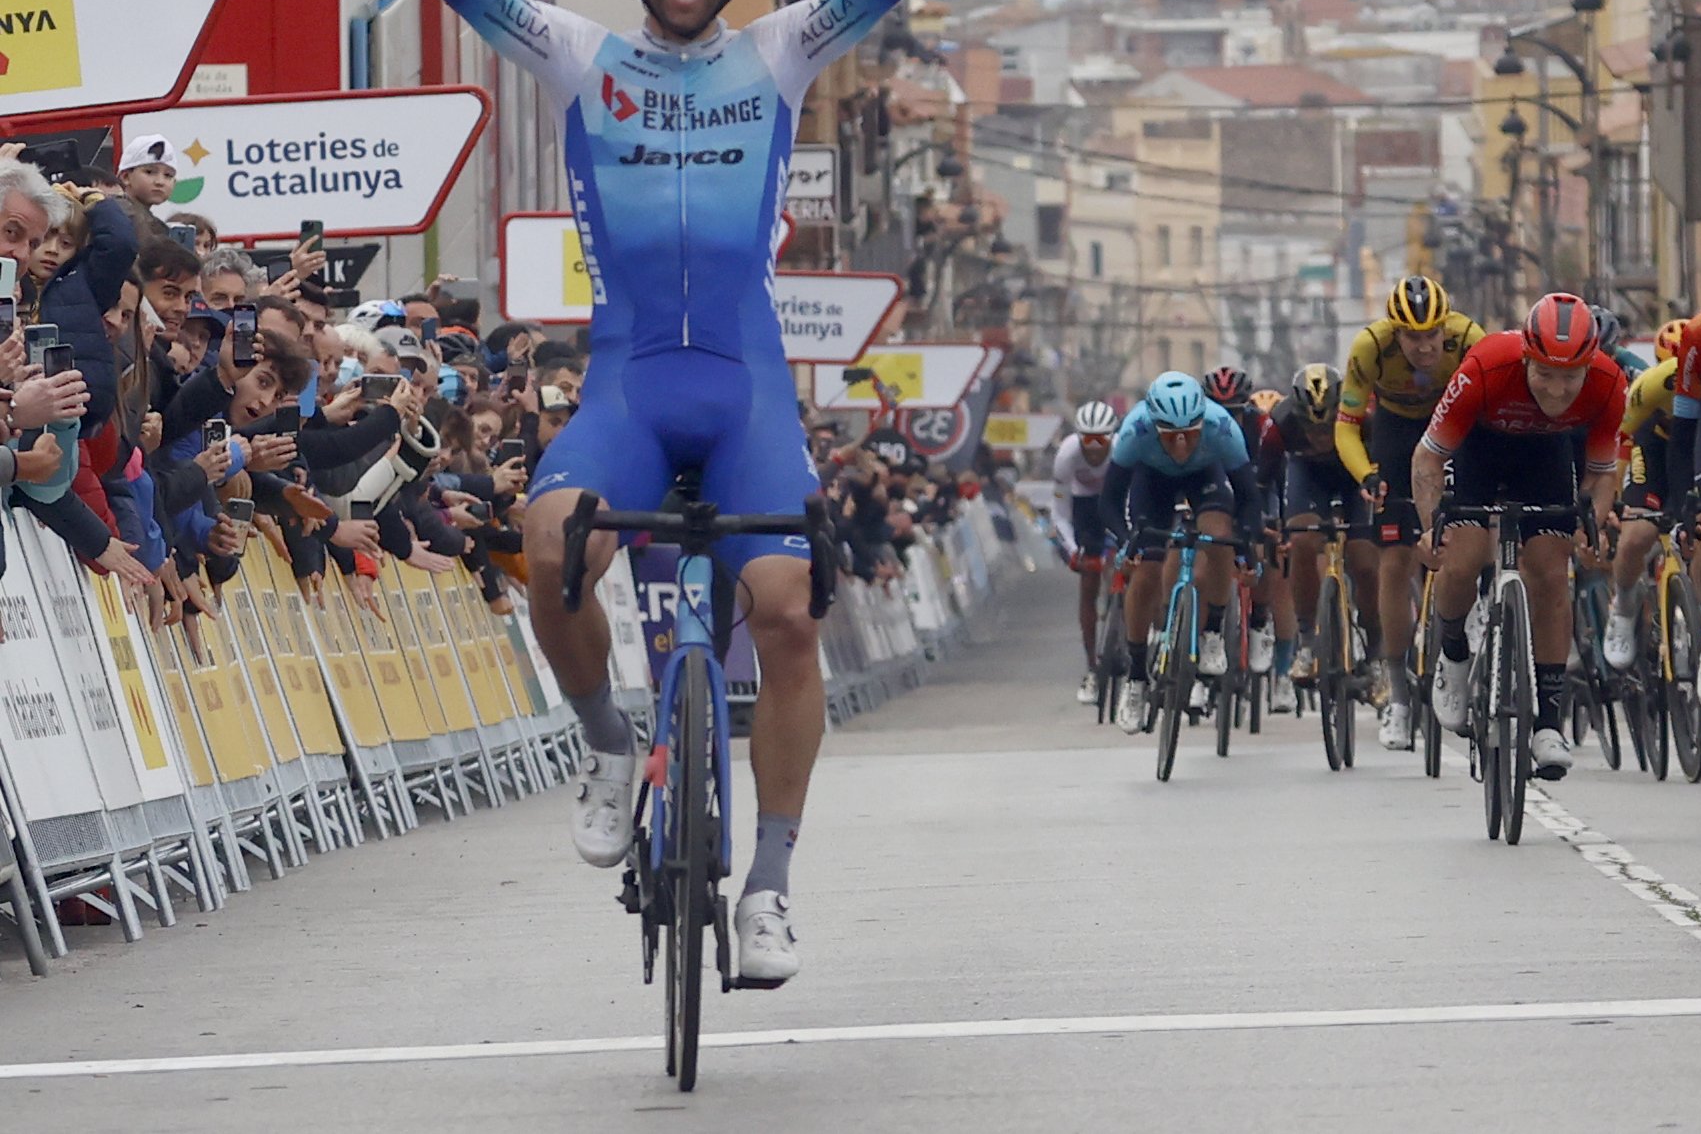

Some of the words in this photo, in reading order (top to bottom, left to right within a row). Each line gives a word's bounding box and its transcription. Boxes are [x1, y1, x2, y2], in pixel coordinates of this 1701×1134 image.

[642, 96, 763, 132] EXCHANGE
[644, 89, 695, 112] BIKE
[226, 132, 367, 166] Loteries
[372, 138, 400, 158] de
[618, 143, 744, 169] Jayco
[227, 166, 403, 199] Catalunya
[780, 319, 843, 341] lunya
